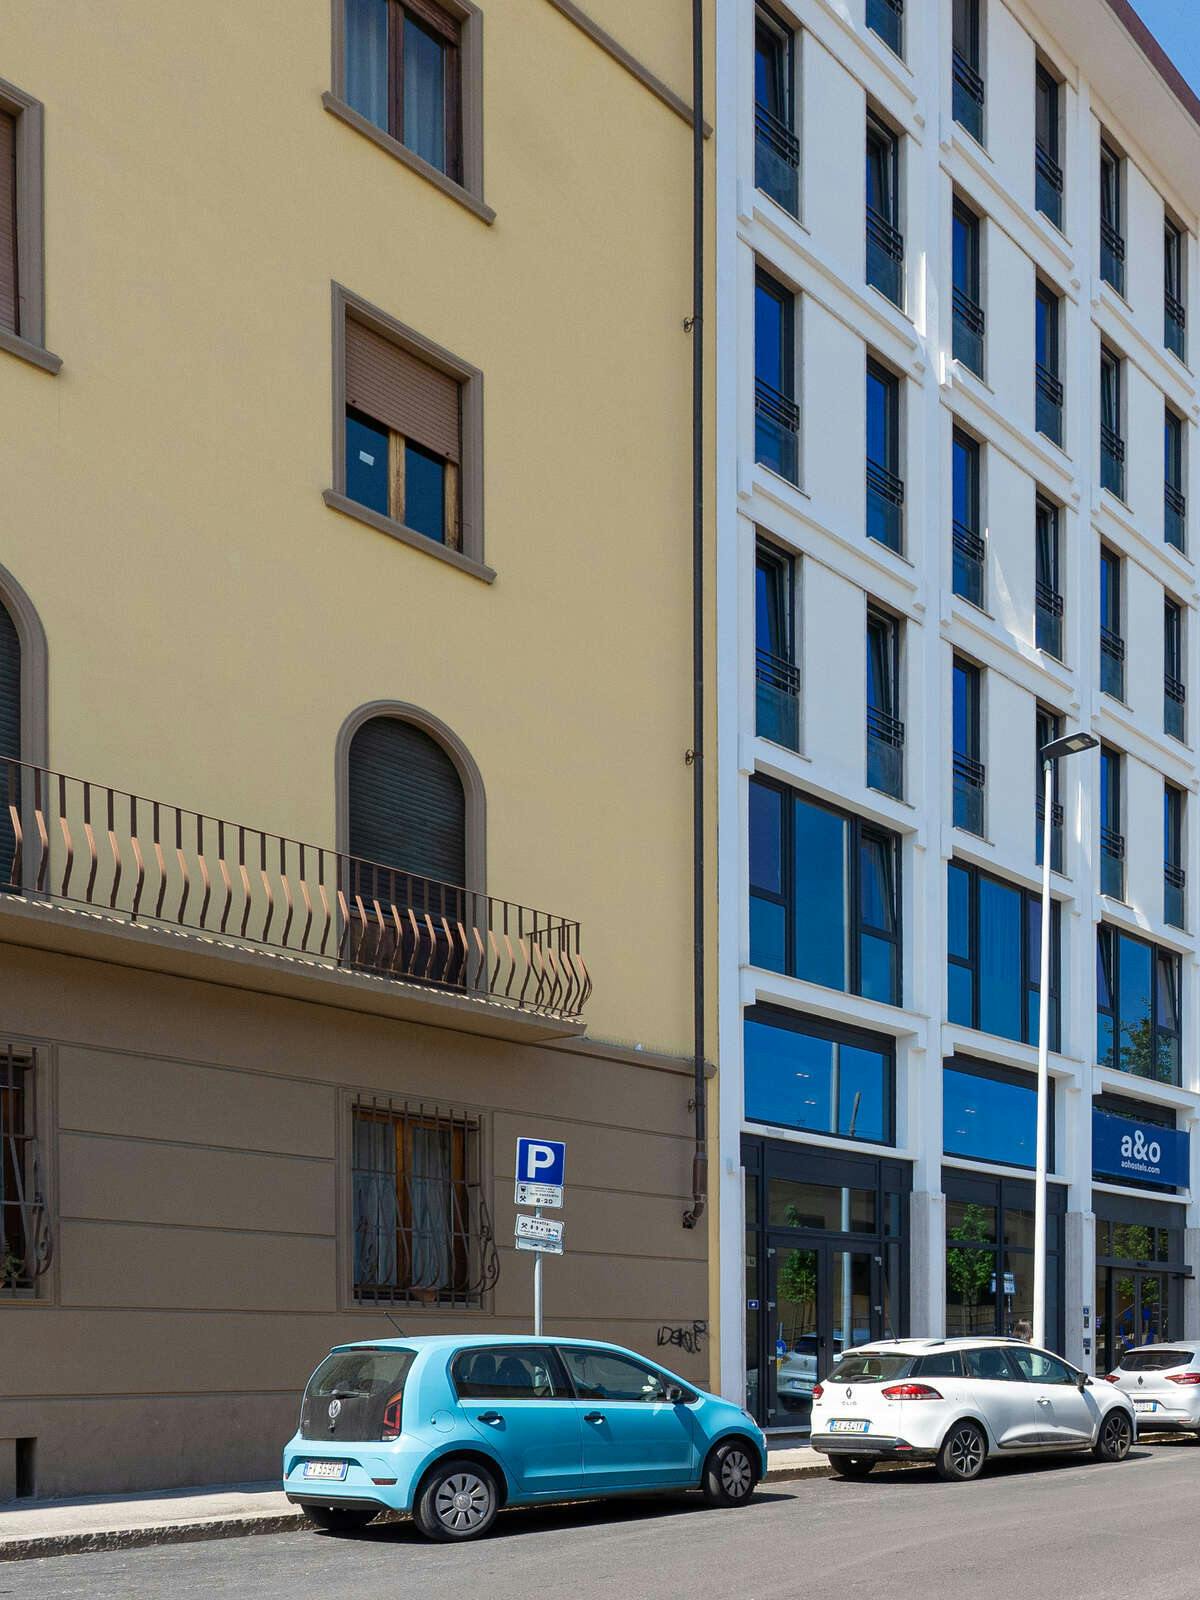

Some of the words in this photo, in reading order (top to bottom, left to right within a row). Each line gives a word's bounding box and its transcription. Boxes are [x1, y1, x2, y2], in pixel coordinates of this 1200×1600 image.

[527, 1144, 555, 1178] P
[1121, 1129, 1160, 1163] a&o
[1121, 1160, 1160, 1174] aohostels.com
